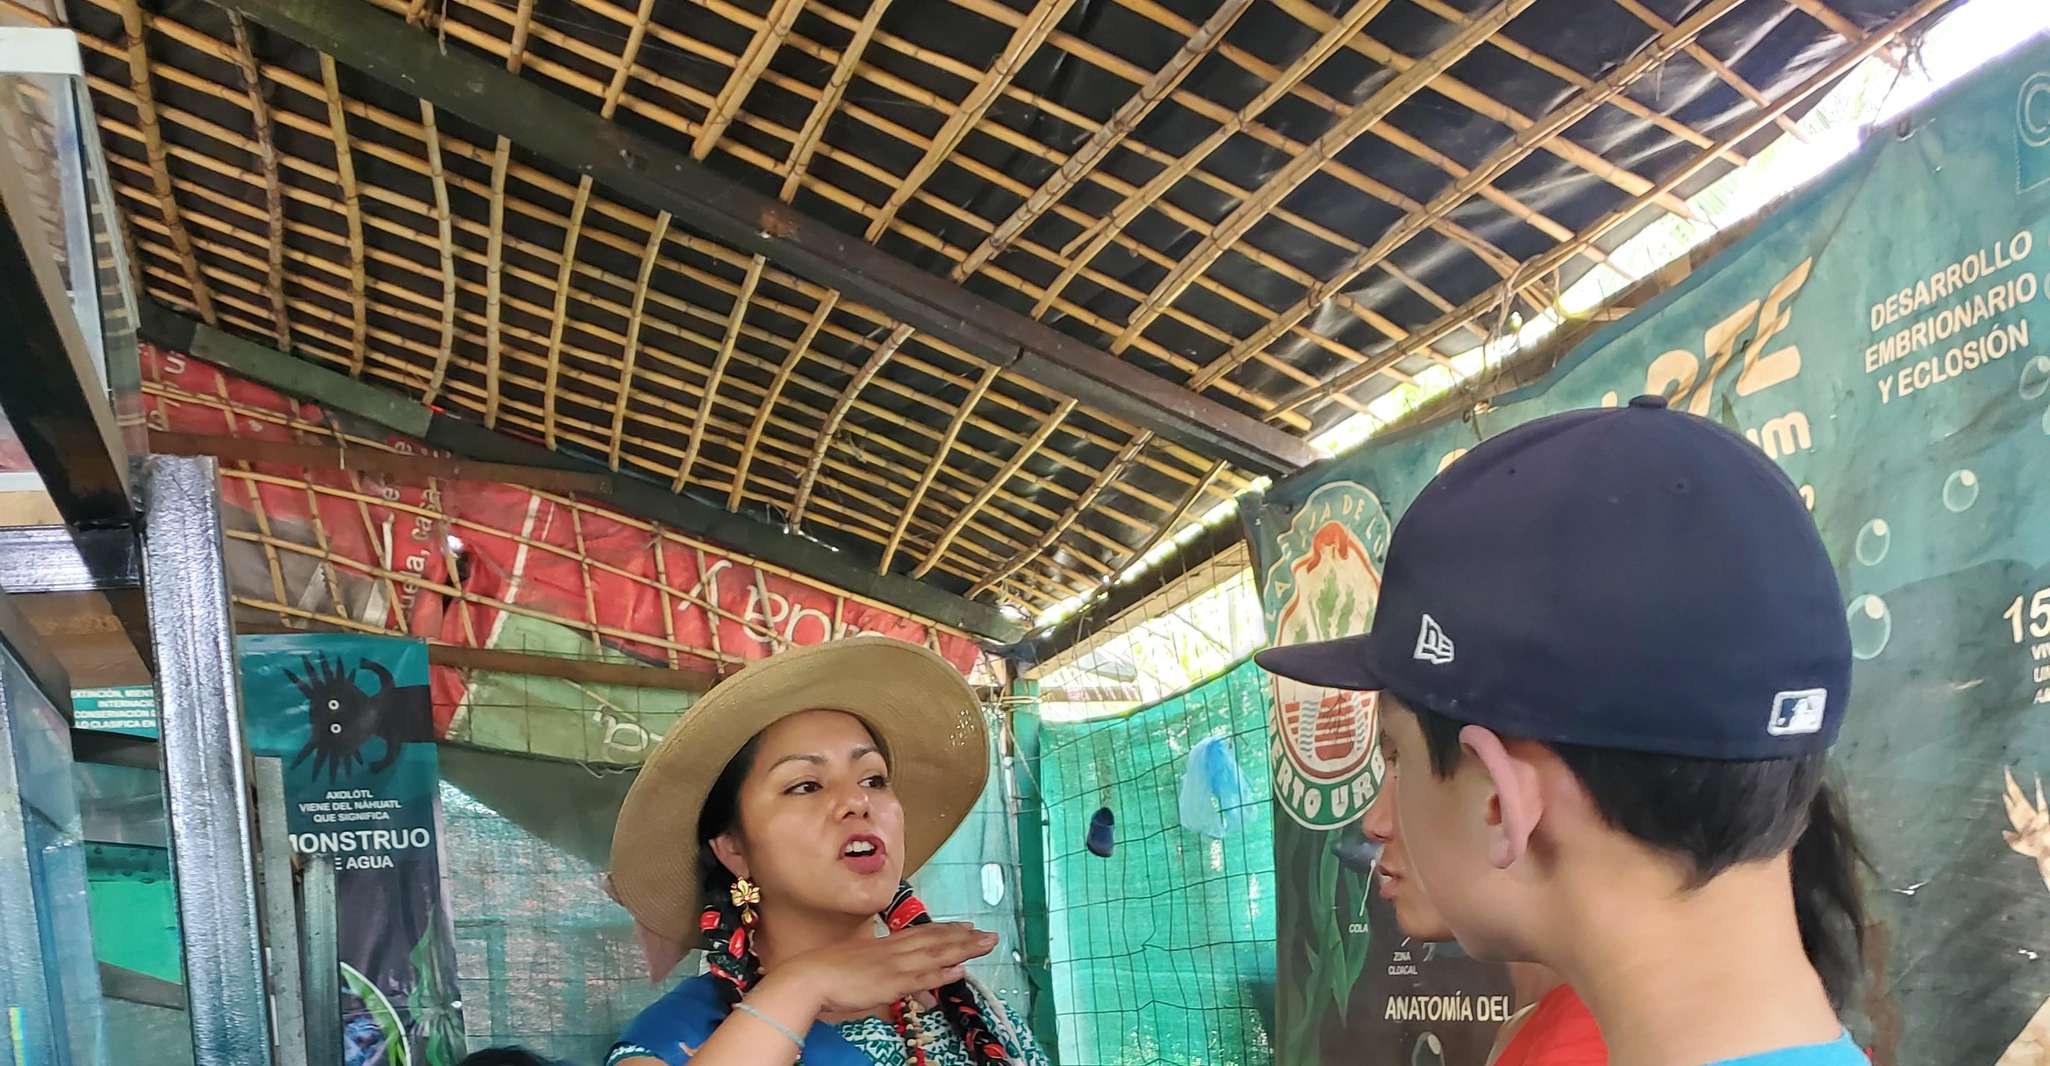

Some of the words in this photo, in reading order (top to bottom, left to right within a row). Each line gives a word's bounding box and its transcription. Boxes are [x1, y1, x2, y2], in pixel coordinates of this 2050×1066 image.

[1871, 230, 2033, 333] DESARROLLO
[1865, 272, 2038, 374] EMBRIONARIO
[1878, 375, 1893, 404] Y
[1898, 318, 2029, 397] ECLOSIÓN
[1331, 744, 1386, 819] URB
[299, 803, 330, 813] VIENE
[332, 802, 353, 811] DEL
[313, 813, 336, 823] QUE
[338, 811, 390, 822] SIGNIFICA
[346, 855, 394, 870] AGUA
[1349, 923, 1368, 934] COLA
[1384, 990, 1473, 1021] ANATOMÍA
[1476, 995, 1512, 1022] DEL
